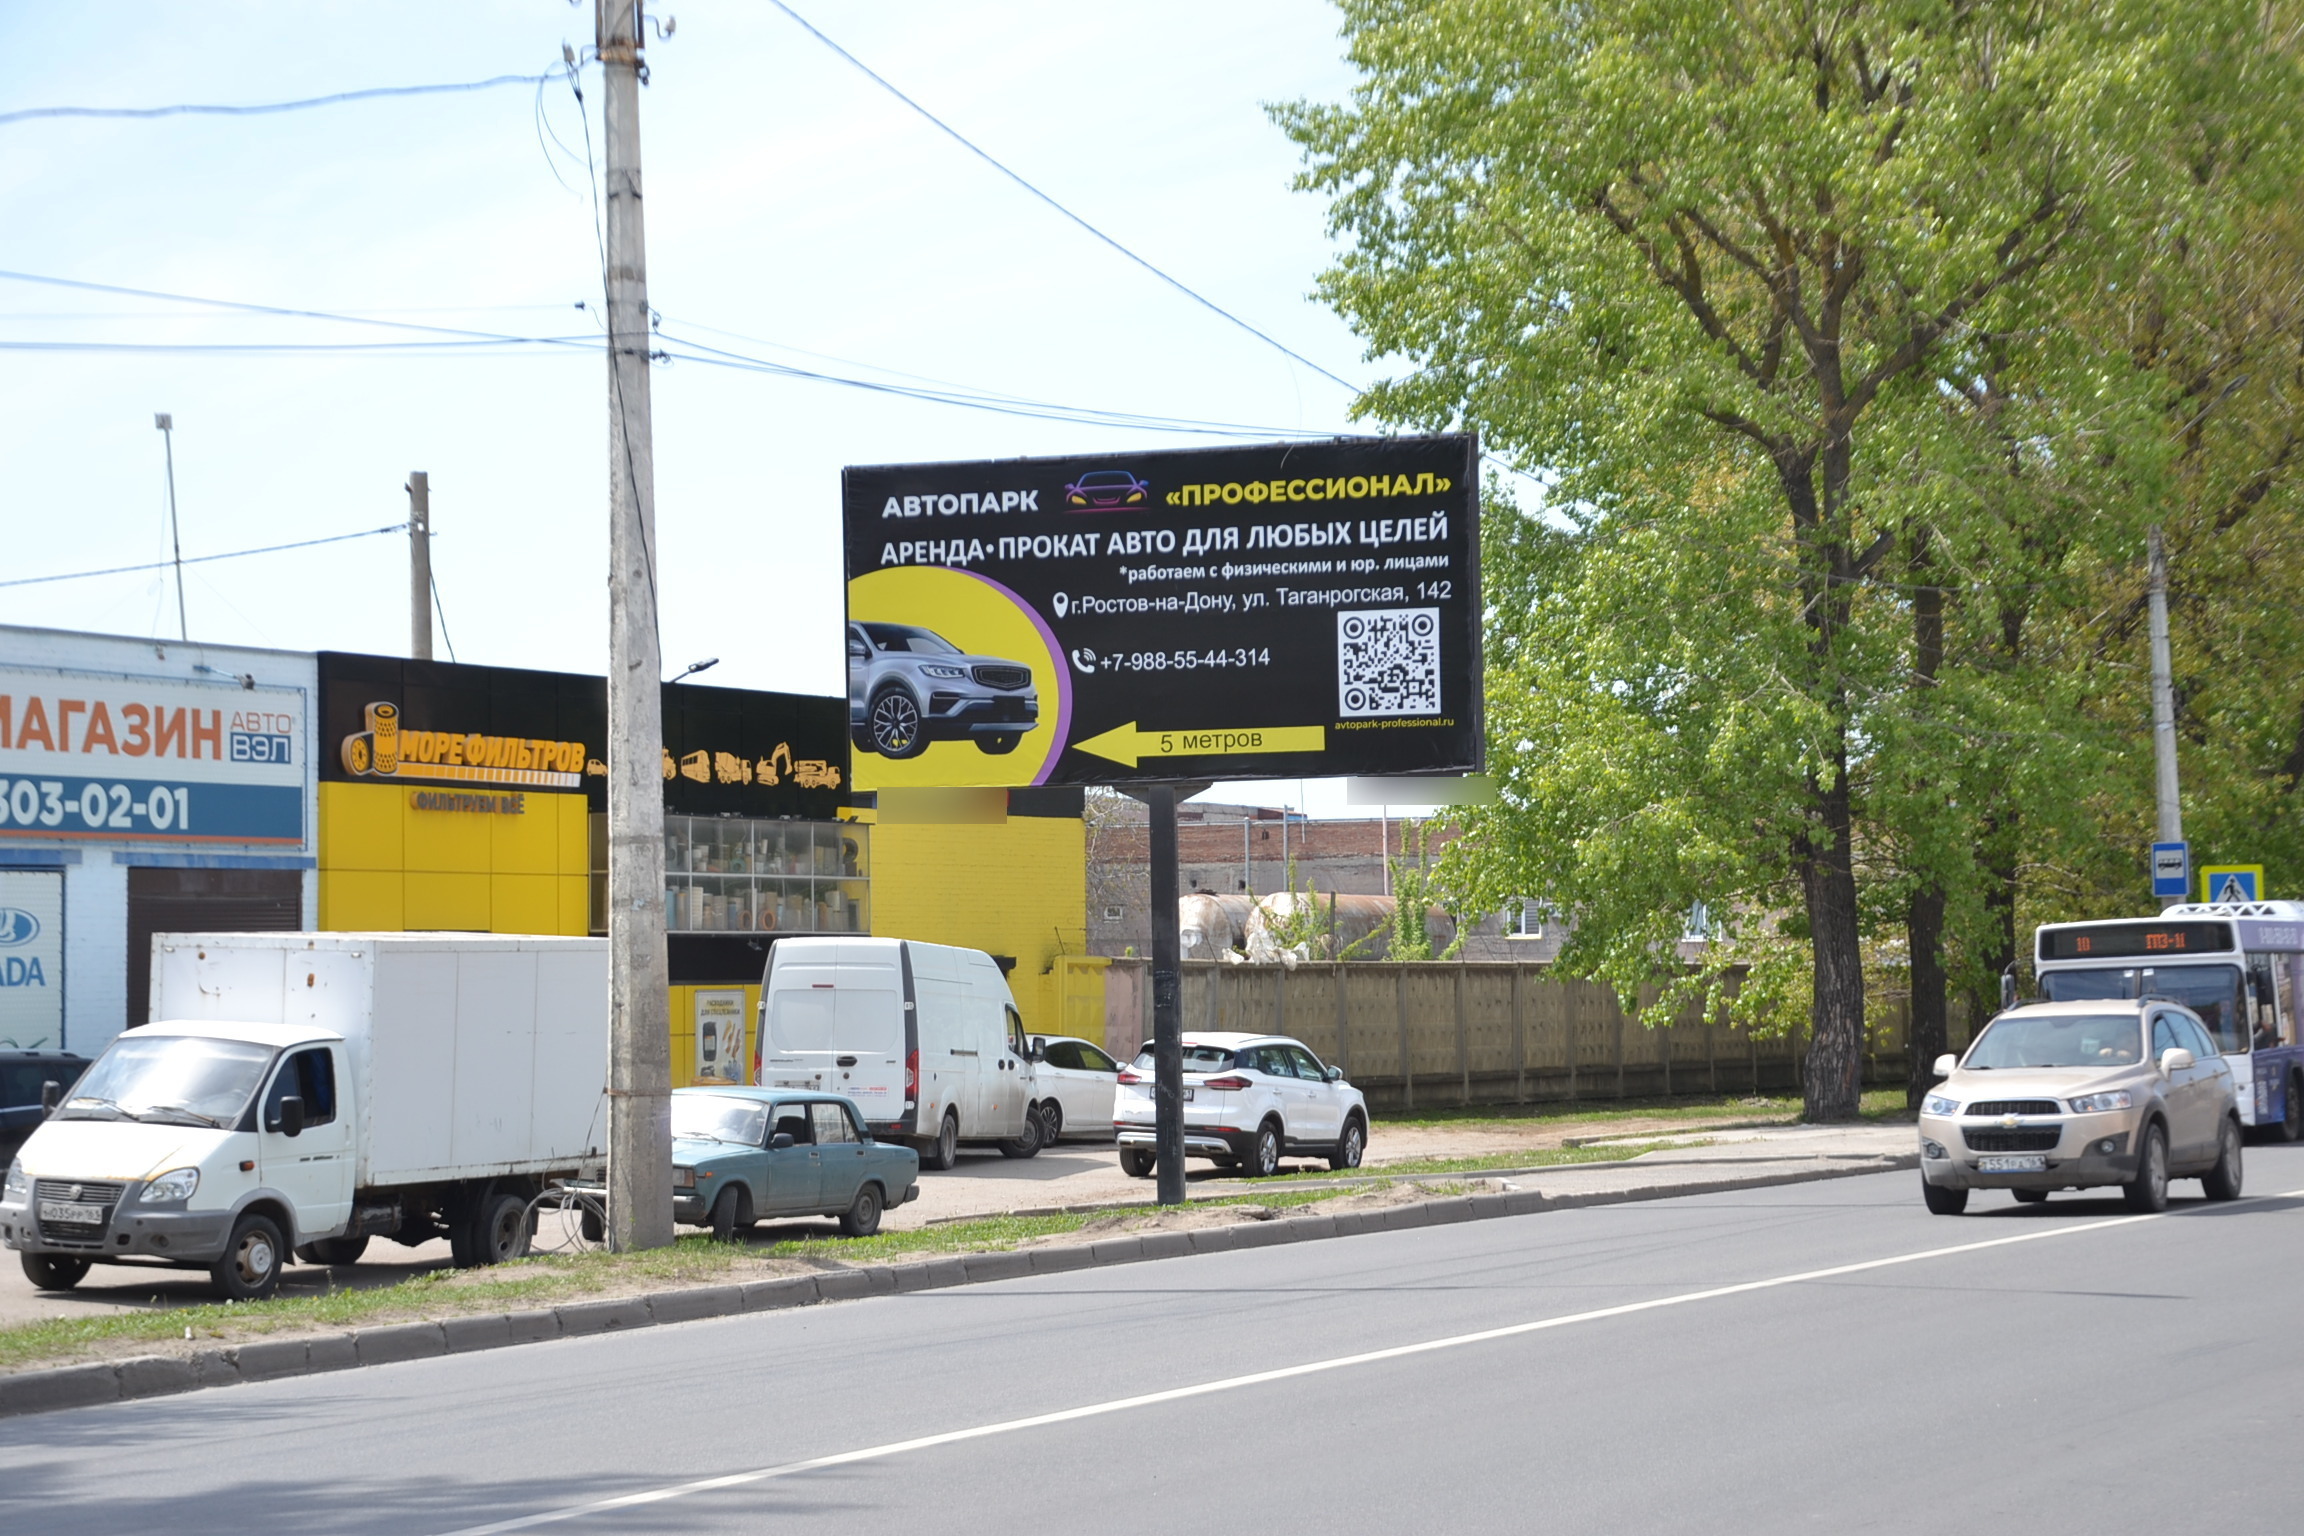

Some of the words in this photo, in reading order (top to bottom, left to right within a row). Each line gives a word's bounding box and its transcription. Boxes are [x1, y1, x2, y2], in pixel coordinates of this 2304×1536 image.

[881, 489, 1039, 518] АВТОПАРК
[1165, 472, 1452, 506] «ПРОФЕССИОНАЛ»
[1106, 529, 1176, 556] АВТО
[1182, 526, 1240, 557] ДЛЯ
[1246, 520, 1352, 549] ЛЮБЫХ
[1359, 509, 1449, 548] ЦЕЛЕЙ
[1209, 566, 1218, 578] с
[1221, 559, 1332, 580] физическими
[1336, 559, 1347, 571] и
[1351, 557, 1380, 575] юр.
[1383, 554, 1449, 573] лицами
[1242, 592, 1270, 612] ул.
[1276, 584, 1410, 609] Таганрогская,
[1416, 579, 1452, 600] 142
[1100, 647, 1271, 672] +7-988-55-44-314
[0, 694, 222, 761] АГАЗИН
[230, 711, 292, 734] АВТО
[1334, 716, 1455, 731] avtopark-professional.ru
[231, 734, 290, 763] ВЭЛ
[398, 729, 467, 765] МОРЕ
[463, 733, 586, 773] ФИЛЬТРОВ
[1160, 734, 1174, 753] 5
[1182, 732, 1263, 752] метров
[2076, 936, 2091, 952] 10
